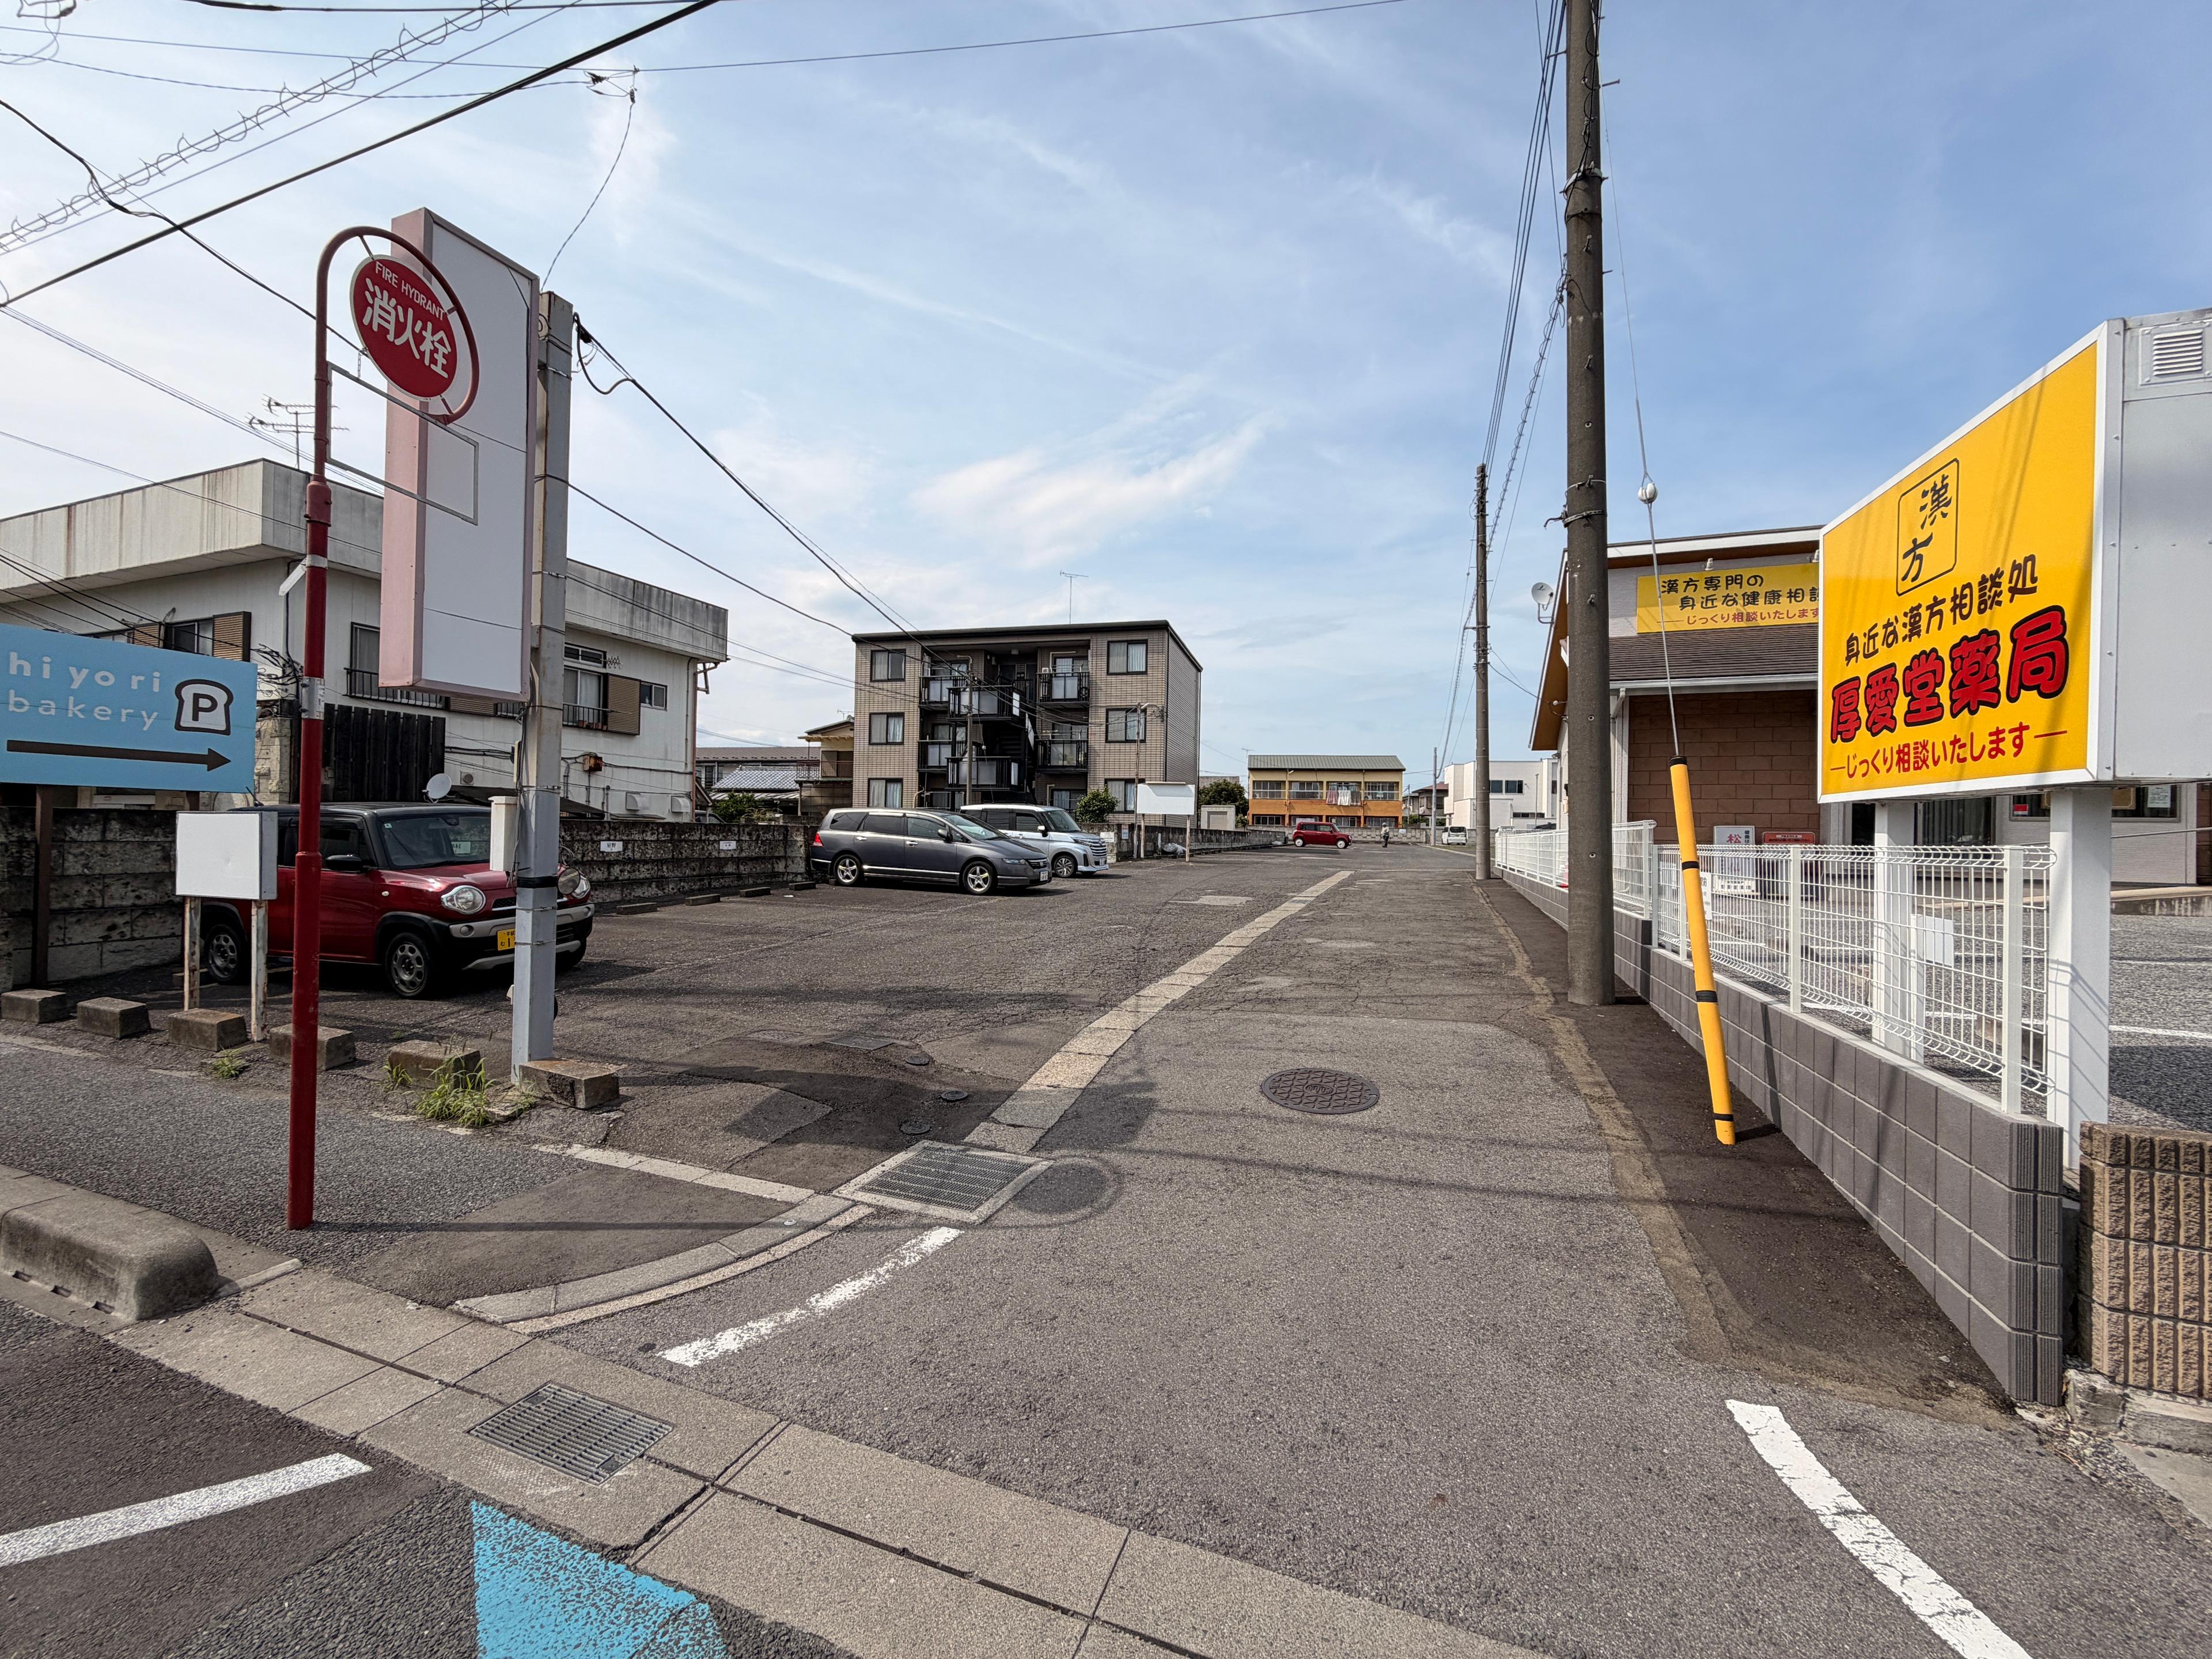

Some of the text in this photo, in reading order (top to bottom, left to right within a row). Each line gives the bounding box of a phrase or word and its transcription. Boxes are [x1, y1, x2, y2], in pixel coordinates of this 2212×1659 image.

[376, 261, 445, 321] FIRE HYDRANT
[362, 278, 452, 378] 消火栓
[1661, 574, 1764, 594] 漢方専門の
[1844, 554, 2039, 667] 身近な漢方相談処
[1830, 605, 2070, 743] 厚愛堂薬局
[8, 690, 158, 731] bakery
[192, 692, 218, 722] P
